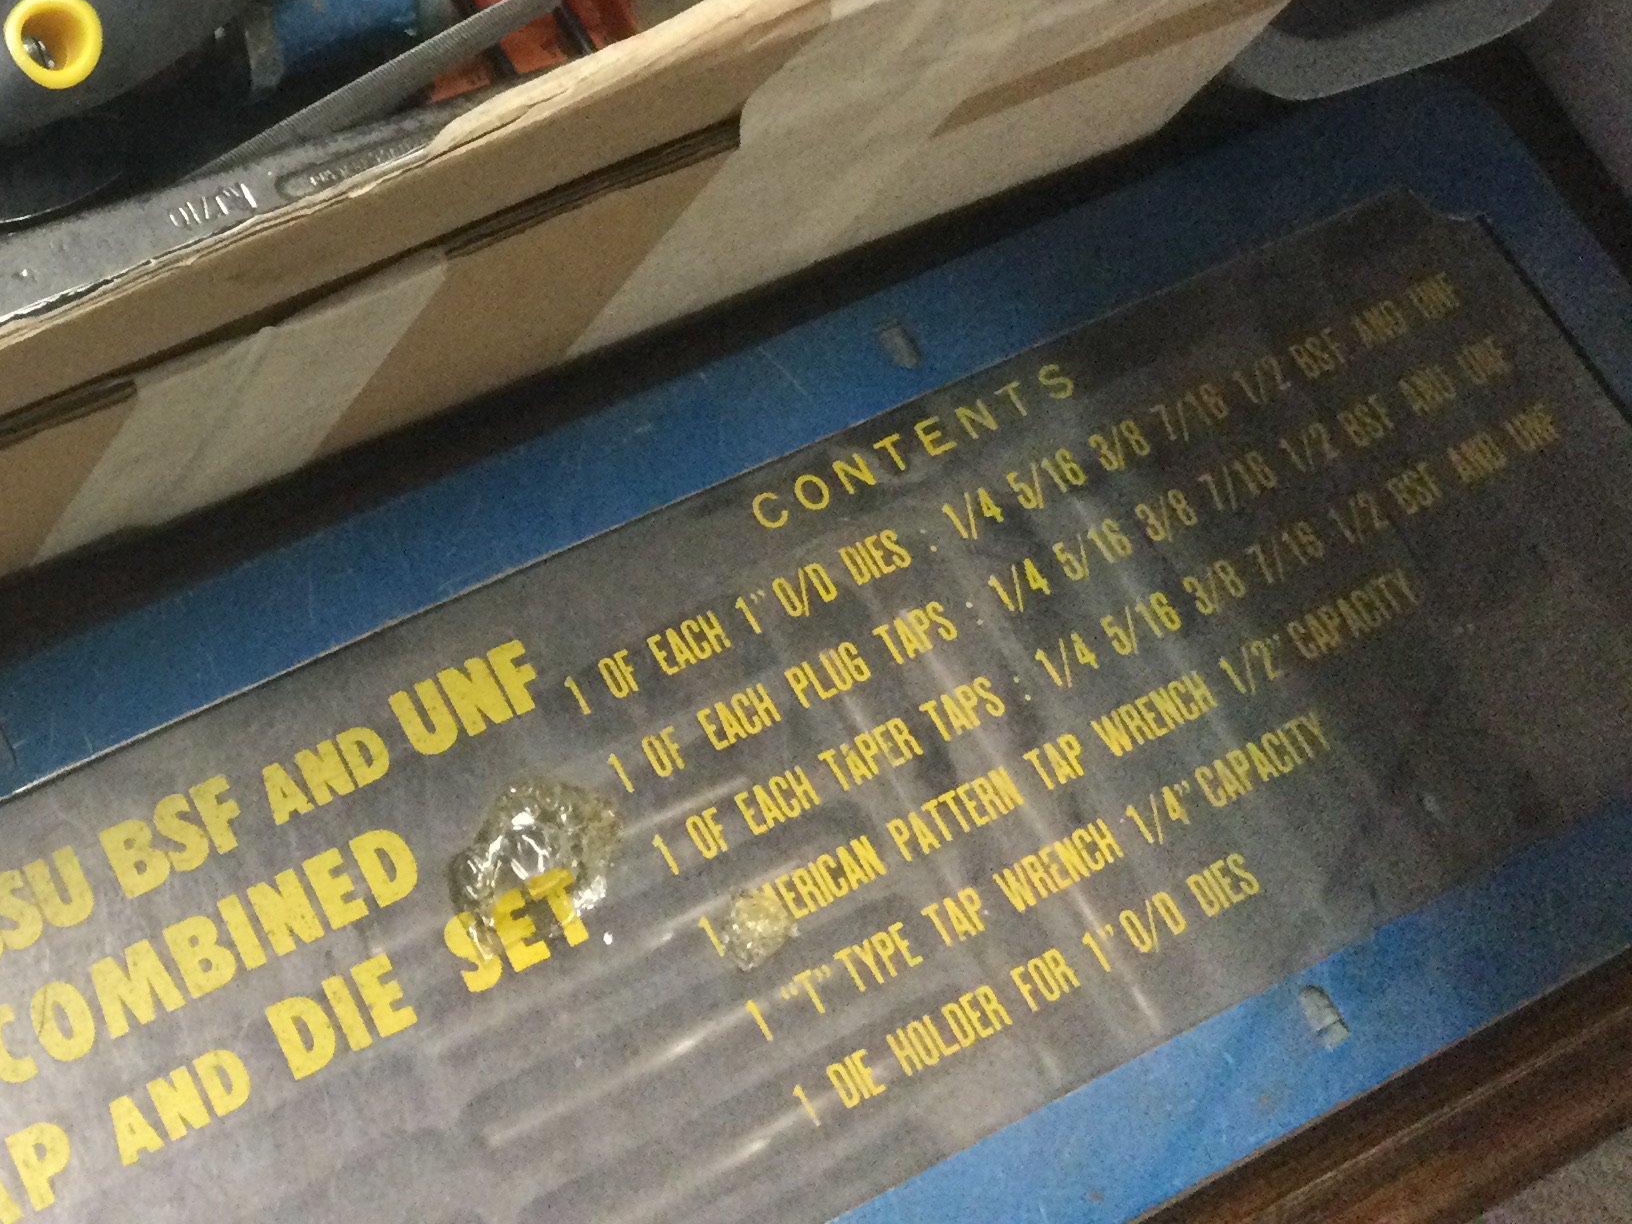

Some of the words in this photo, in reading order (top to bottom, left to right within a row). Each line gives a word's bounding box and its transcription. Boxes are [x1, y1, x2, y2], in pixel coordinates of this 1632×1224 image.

[564, 675, 591, 715] 1
[598, 649, 639, 699] OF
[646, 610, 731, 675] EACH
[771, 562, 837, 617] O/D
[838, 529, 912, 585] DIES
[942, 487, 1005, 540] 1/4
[1006, 448, 1088, 509] 5/16
[1088, 419, 1151, 471] 3/8
[1149, 383, 1230, 443] 7/16
[1234, 355, 1292, 406] 1/2
[1288, 326, 1346, 378] BSF
[1350, 300, 1408, 349] AND
[608, 752, 635, 793] 1
[641, 725, 685, 778] OF
[696, 683, 782, 751] EACH
[784, 642, 872, 709] PLUG
[872, 601, 958, 665] TAPS
[988, 558, 1051, 613] 1/4
[1052, 518, 1133, 582] 5/16
[1135, 489, 1198, 543] 3/8
[1198, 451, 1278, 512] 7/16
[1279, 423, 1340, 474] 1/2
[1336, 392, 1395, 447] BSF
[751, 363, 1075, 528] CONTENTS
[98, 775, 242, 899] BSF
[260, 726, 390, 827] AND
[387, 639, 539, 756] UNF
[652, 833, 680, 875] 1
[685, 806, 728, 860] OF
[734, 765, 821, 835] EACH
[818, 717, 924, 791] TAPER
[919, 676, 1006, 742] TAPS
[1035, 632, 1100, 688] 1/4
[1100, 591, 1182, 656] 5/16
[1182, 559, 1247, 616] 3/8
[1244, 520, 1325, 584] 7/16
[1328, 491, 1389, 547] 1/2
[1386, 462, 1443, 515] BSF
[698, 915, 727, 957] 1
[741, 835, 887, 932] MERICAN
[886, 766, 1024, 862] PATTERN
[1023, 733, 1085, 790] TAP
[1090, 670, 1218, 758] WRENCH
[1286, 567, 1421, 661] CAPACITY
[109, 1048, 252, 1166] AND
[265, 954, 418, 1080] DIE
[443, 867, 591, 993] SET
[745, 999, 773, 1042] 1
[833, 922, 923, 992] TYPE
[921, 887, 986, 947] TAP
[992, 818, 1125, 914] WRENCH
[1194, 712, 1330, 809] CAPACITY
[792, 1084, 821, 1127] 1
[826, 1049, 887, 1109] DIE
[885, 985, 1013, 1076] HOLDER
[1009, 948, 1081, 1013] FOR
[1118, 890, 1188, 954] O/D
[1186, 852, 1260, 918] DIES
